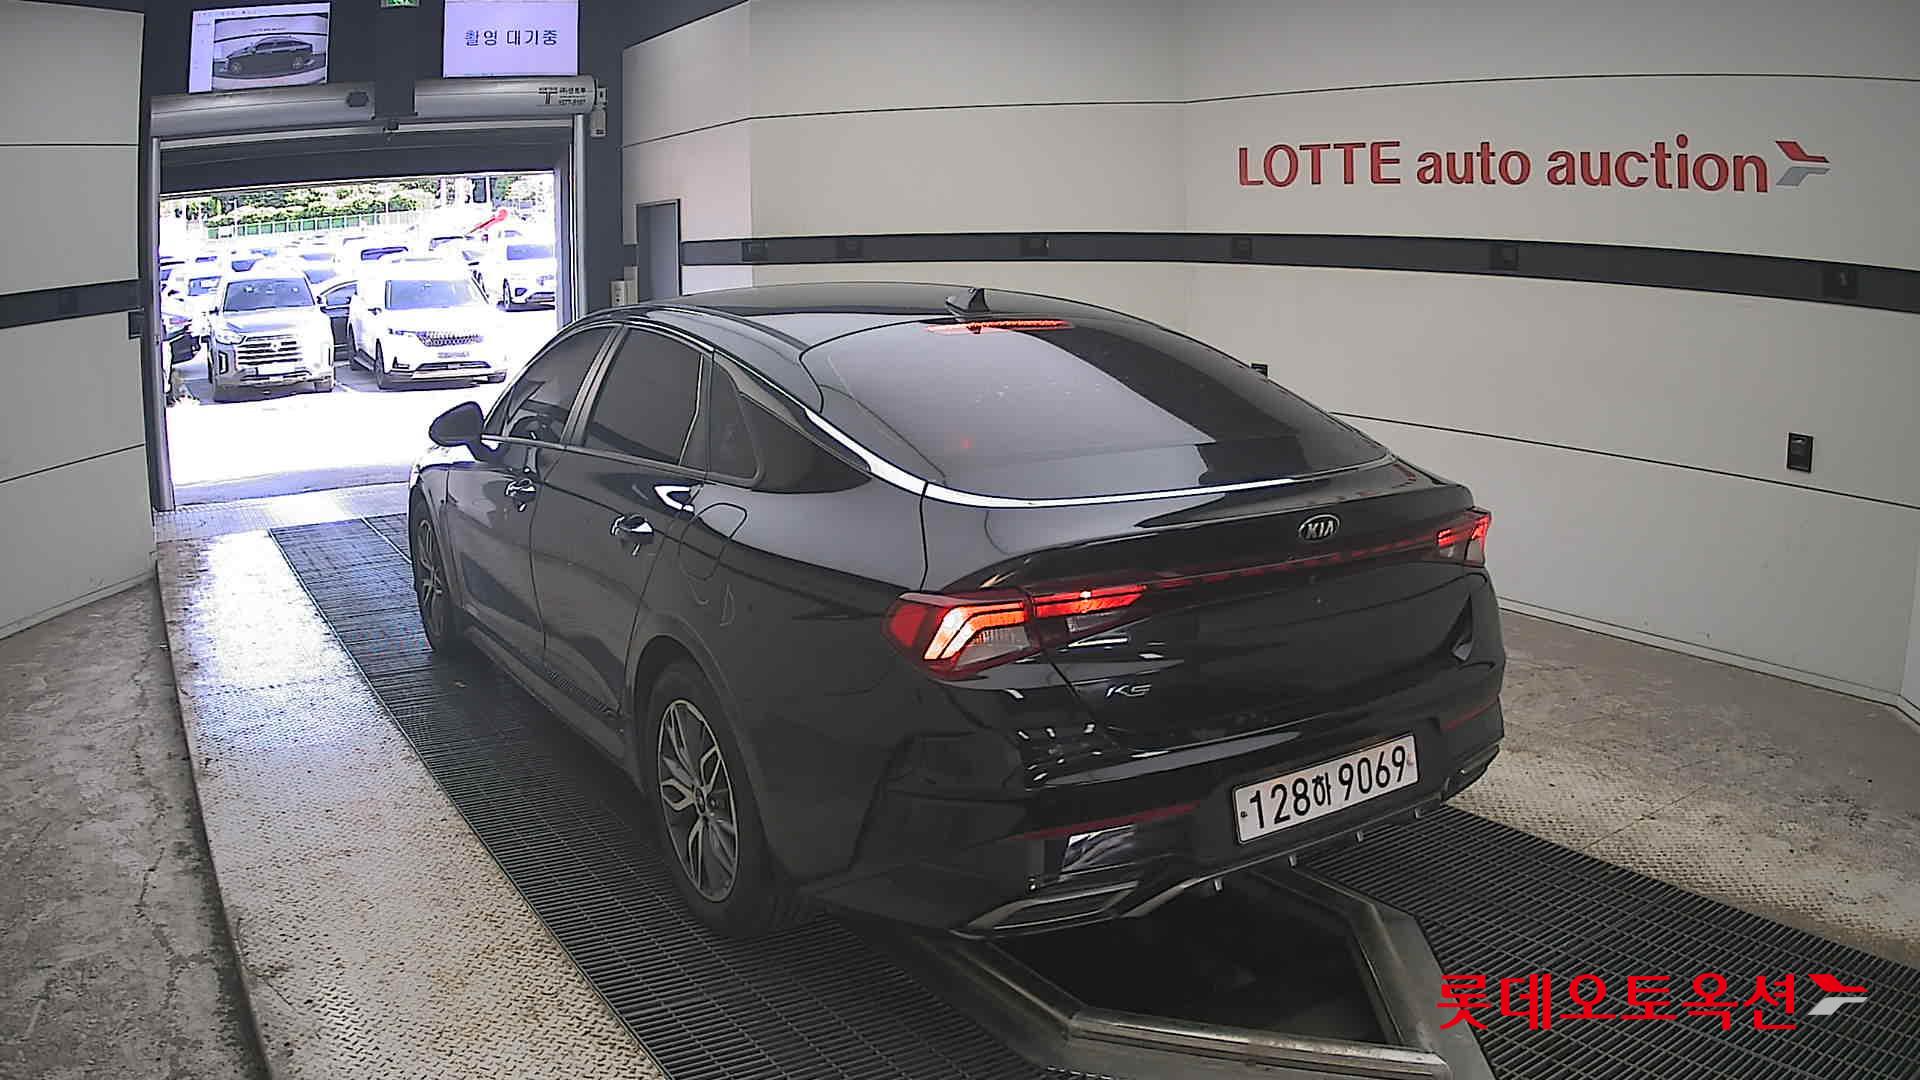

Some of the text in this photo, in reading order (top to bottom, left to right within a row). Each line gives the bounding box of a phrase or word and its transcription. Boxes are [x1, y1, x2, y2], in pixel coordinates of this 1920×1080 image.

[465, 30, 558, 46] 촬영 대기중
[1238, 134, 1768, 193] LOTTE auto auction
[1306, 519, 1335, 539] KIA
[1106, 684, 1152, 697] K5
